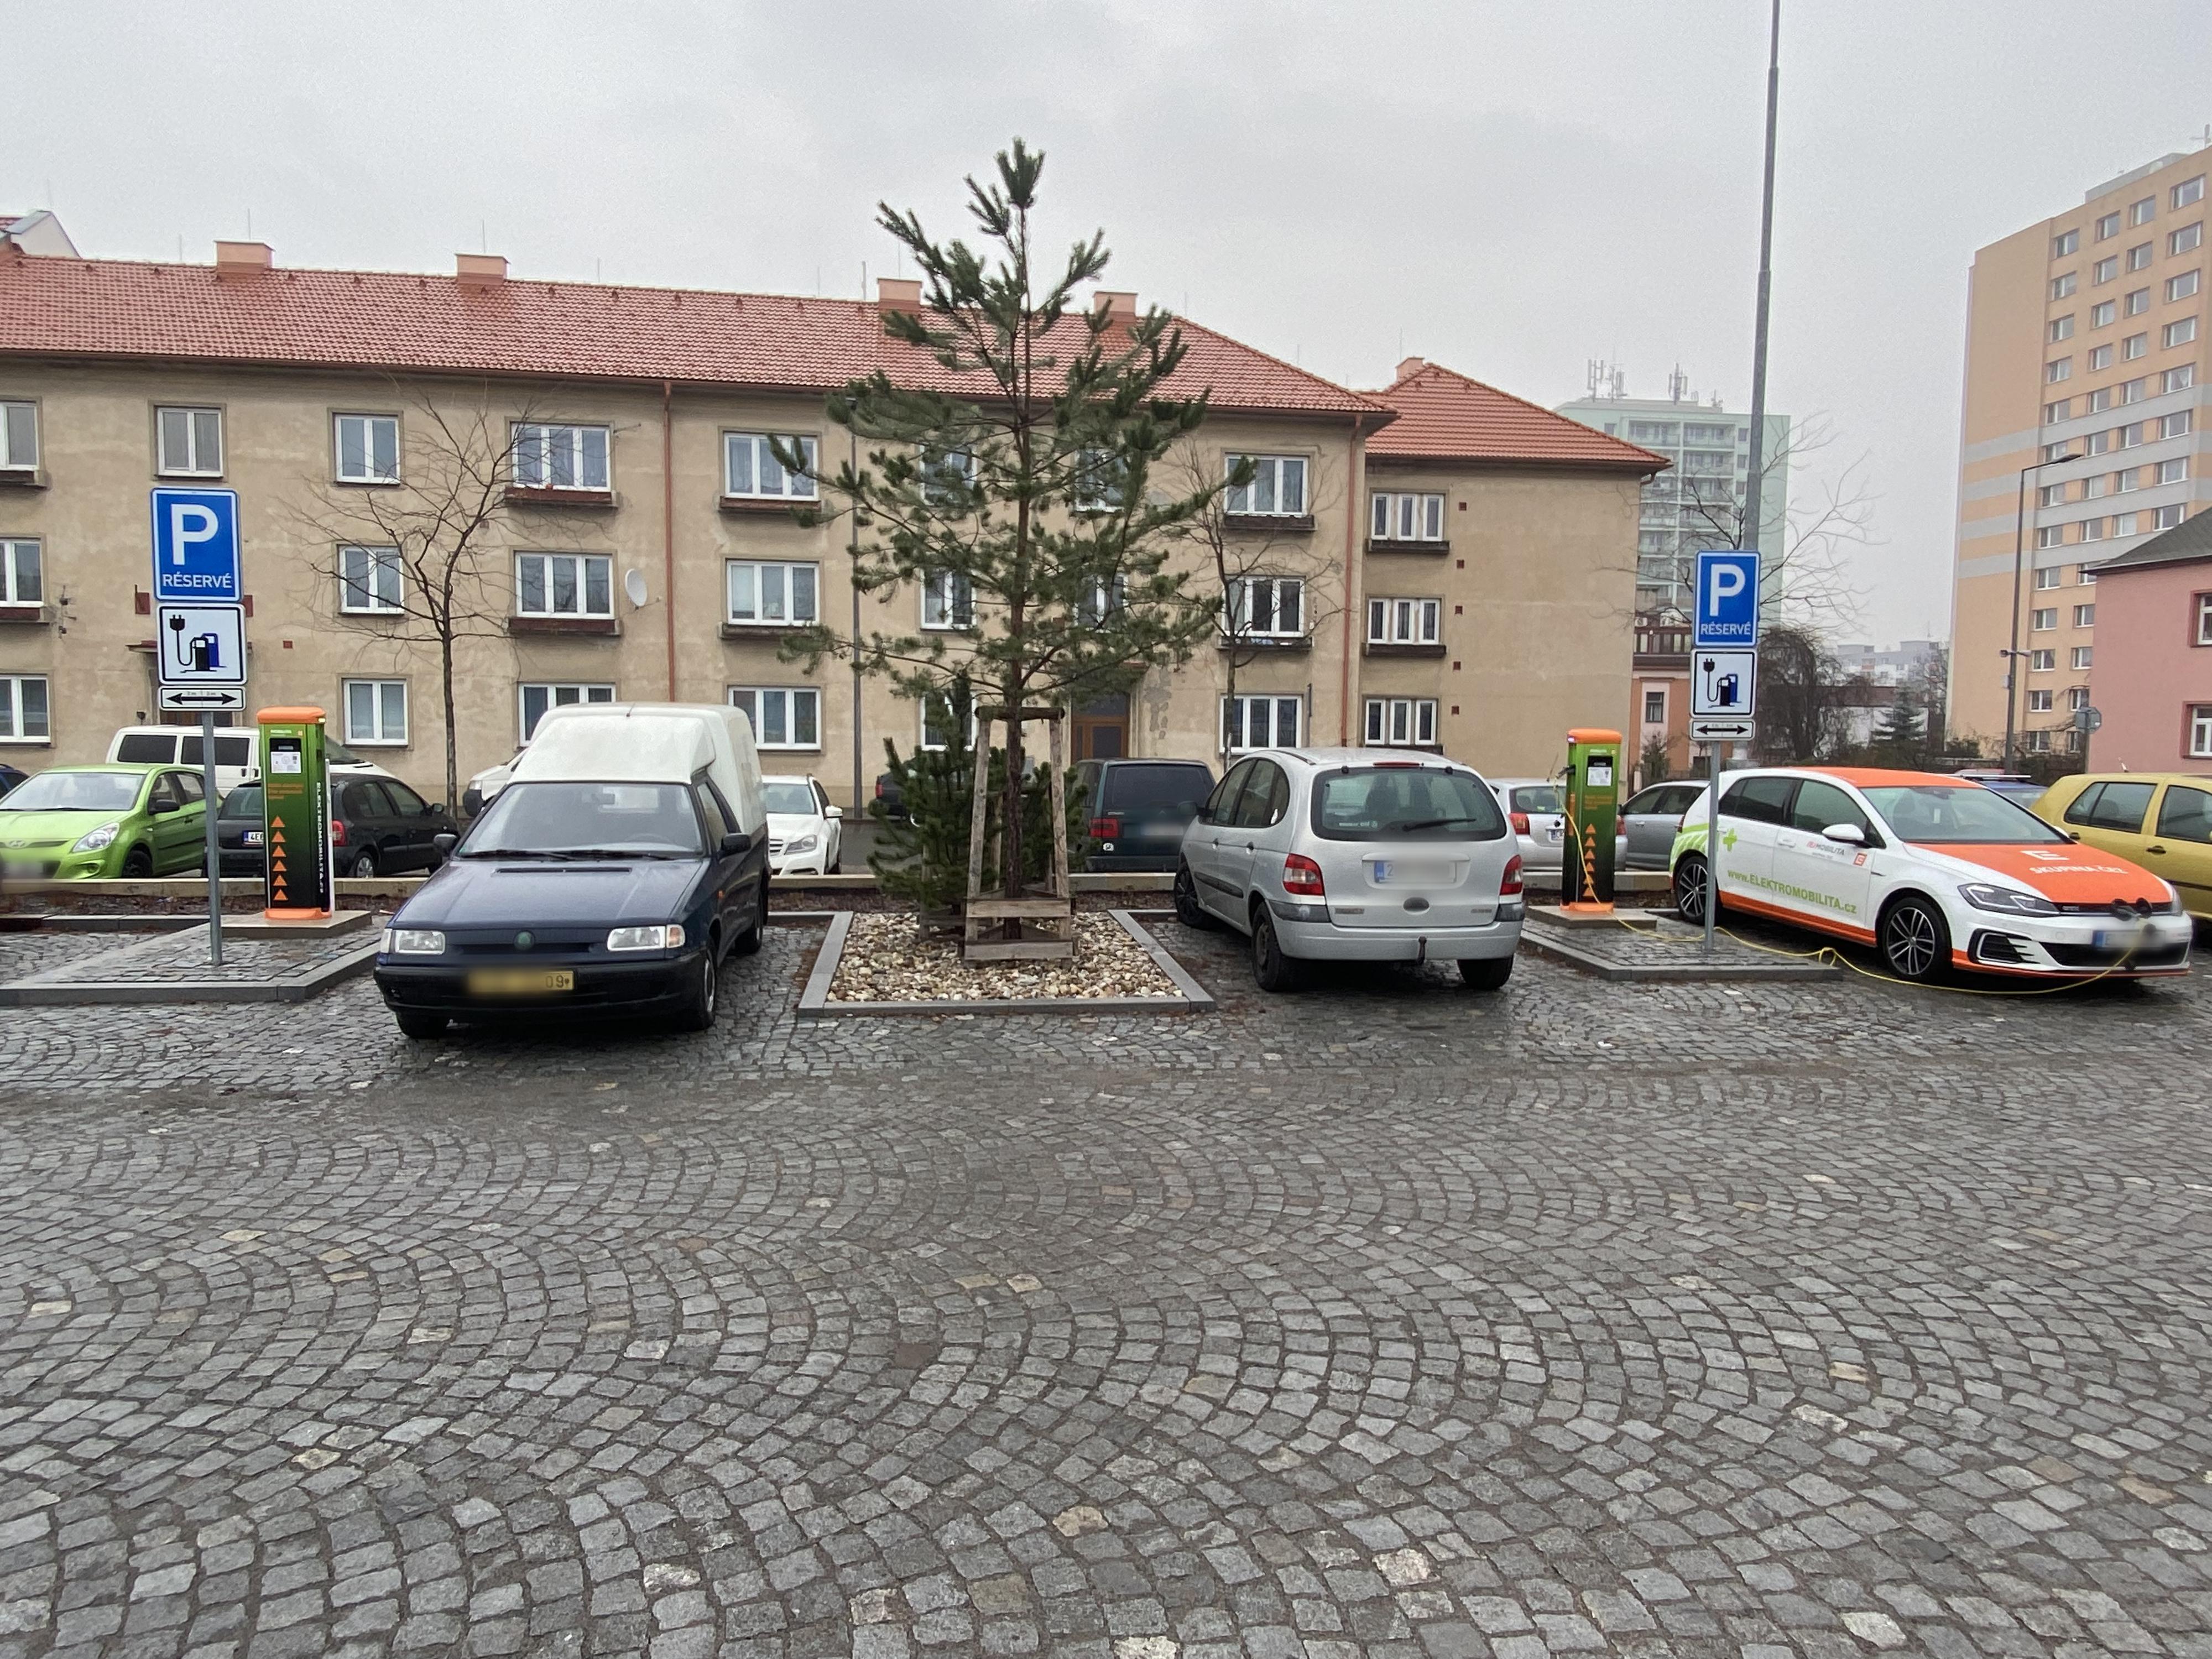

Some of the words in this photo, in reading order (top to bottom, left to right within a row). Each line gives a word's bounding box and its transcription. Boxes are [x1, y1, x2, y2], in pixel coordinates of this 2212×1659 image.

[171, 504, 218, 565] P
[162, 571, 233, 588] RÉSERVÉ
[1709, 564, 1746, 617] P
[1700, 621, 1751, 635] RÉSERVÉ
